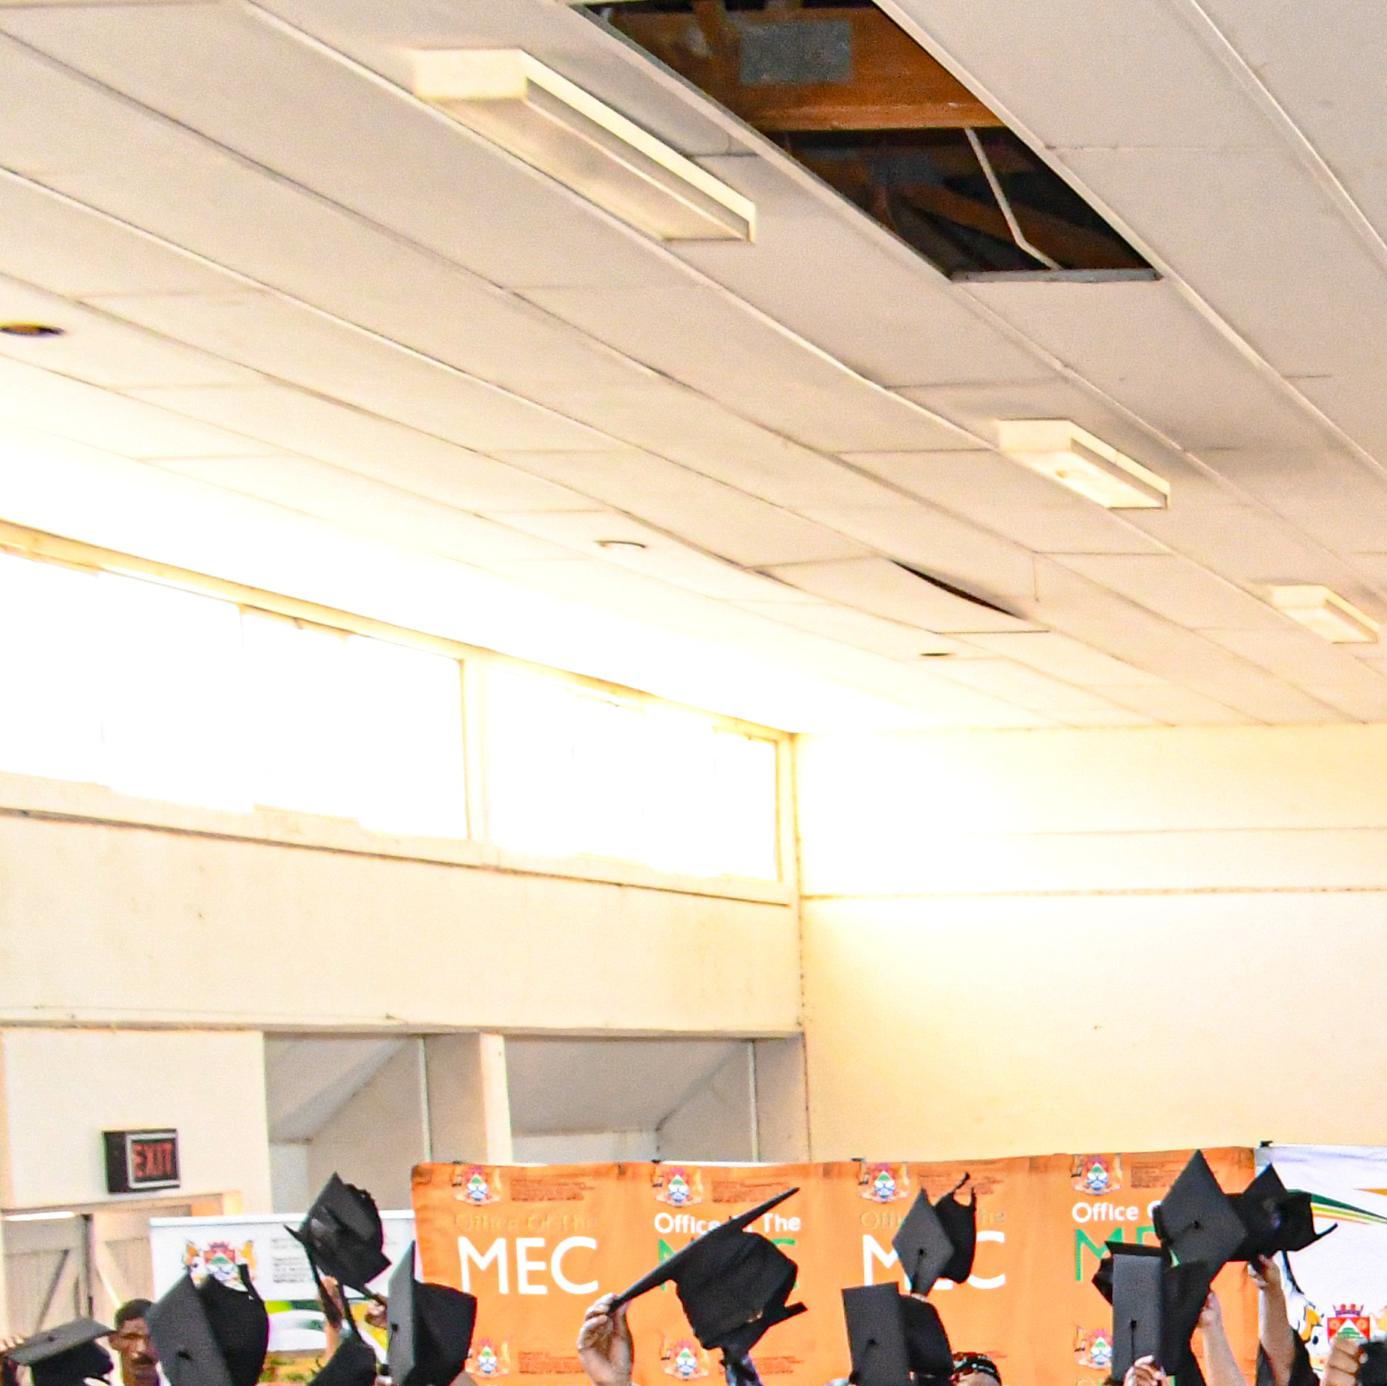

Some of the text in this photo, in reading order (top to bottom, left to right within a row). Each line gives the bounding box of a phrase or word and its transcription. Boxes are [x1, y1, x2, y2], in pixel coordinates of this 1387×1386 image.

[763, 1213, 801, 1232] The
[1072, 1201, 1139, 1223] Office
[457, 1236, 599, 1296] MEC
[862, 1231, 1006, 1290] MC
